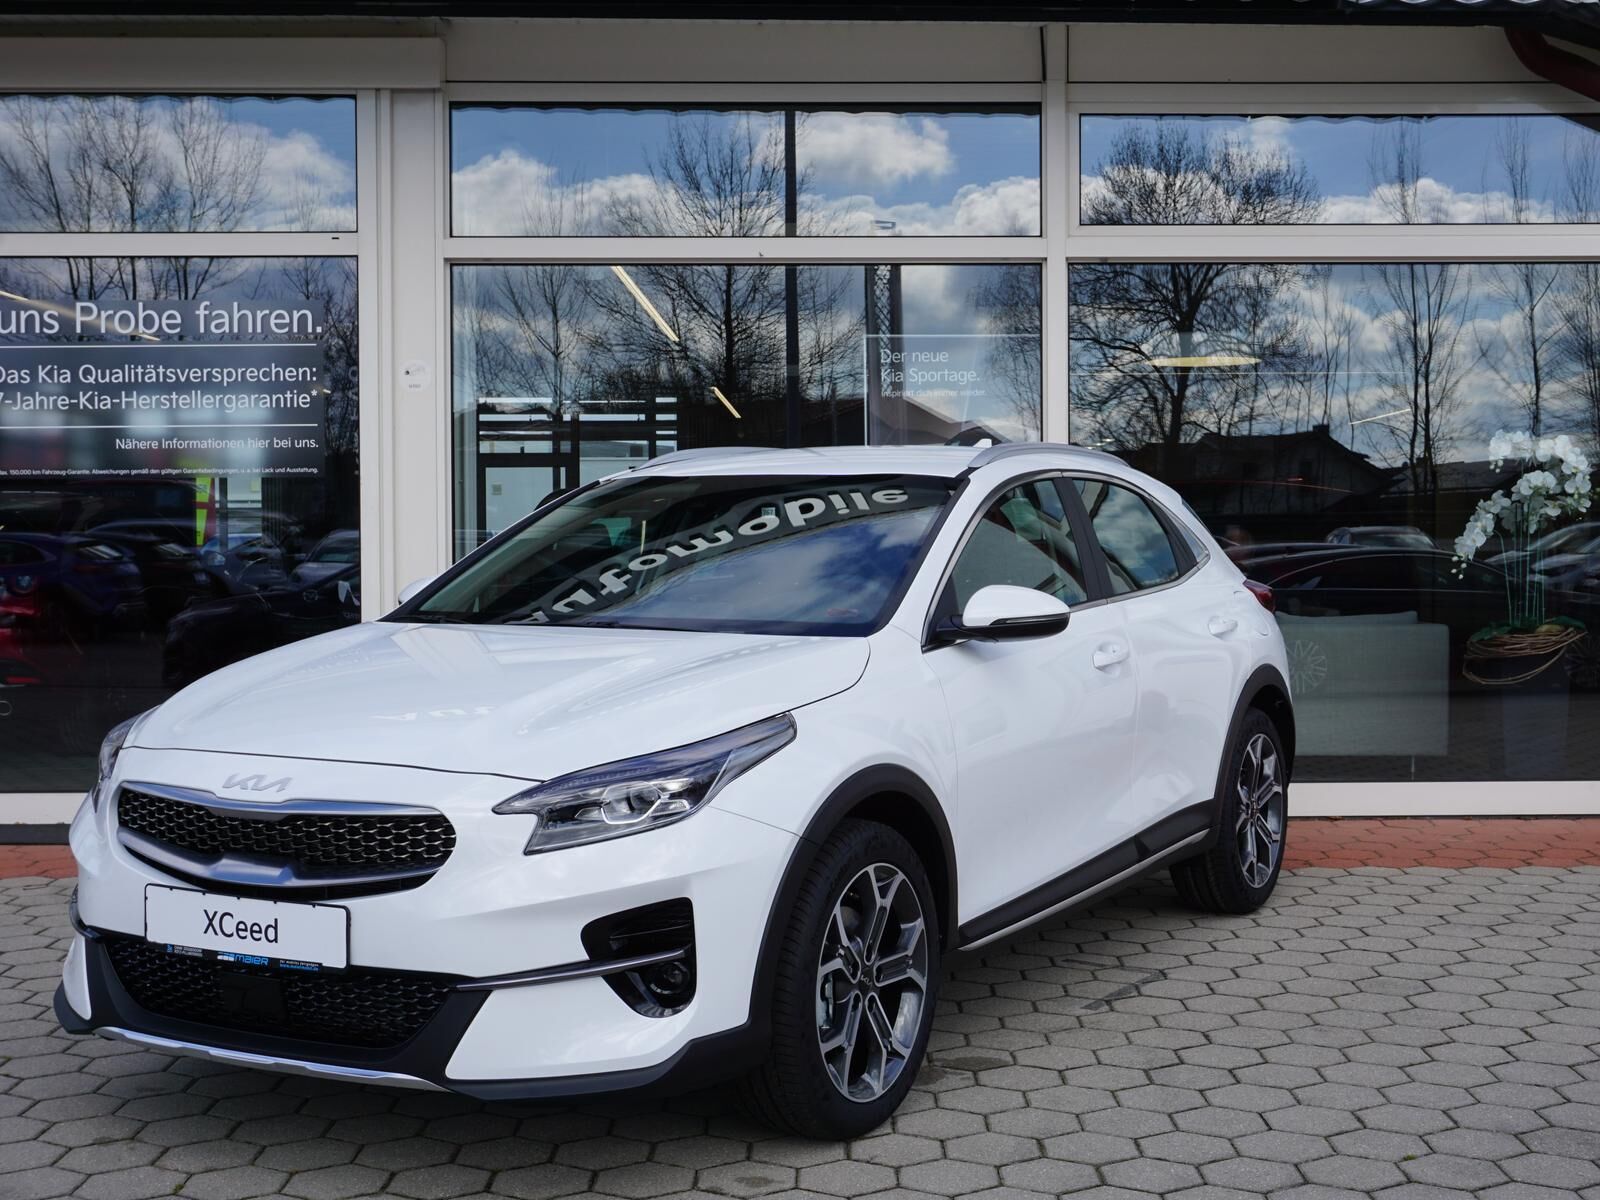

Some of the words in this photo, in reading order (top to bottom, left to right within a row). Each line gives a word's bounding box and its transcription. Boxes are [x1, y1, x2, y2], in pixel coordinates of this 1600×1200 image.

[0, 309, 60, 334] uns
[75, 301, 182, 334] Probe
[195, 301, 323, 334] fahren.
[880, 349, 907, 363] Der
[912, 351, 949, 363] neue
[38, 365, 71, 383] Kia
[79, 363, 317, 387] Qualitätsversprechen:
[880, 368, 904, 382] Kia
[909, 368, 981, 385] Sportage.
[115, 438, 159, 450] Nähere
[162, 438, 246, 449] Informationen
[247, 438, 271, 448] hier
[273, 438, 291, 448] bei
[293, 440, 319, 448] uns.
[203, 909, 279, 944] XCeed
